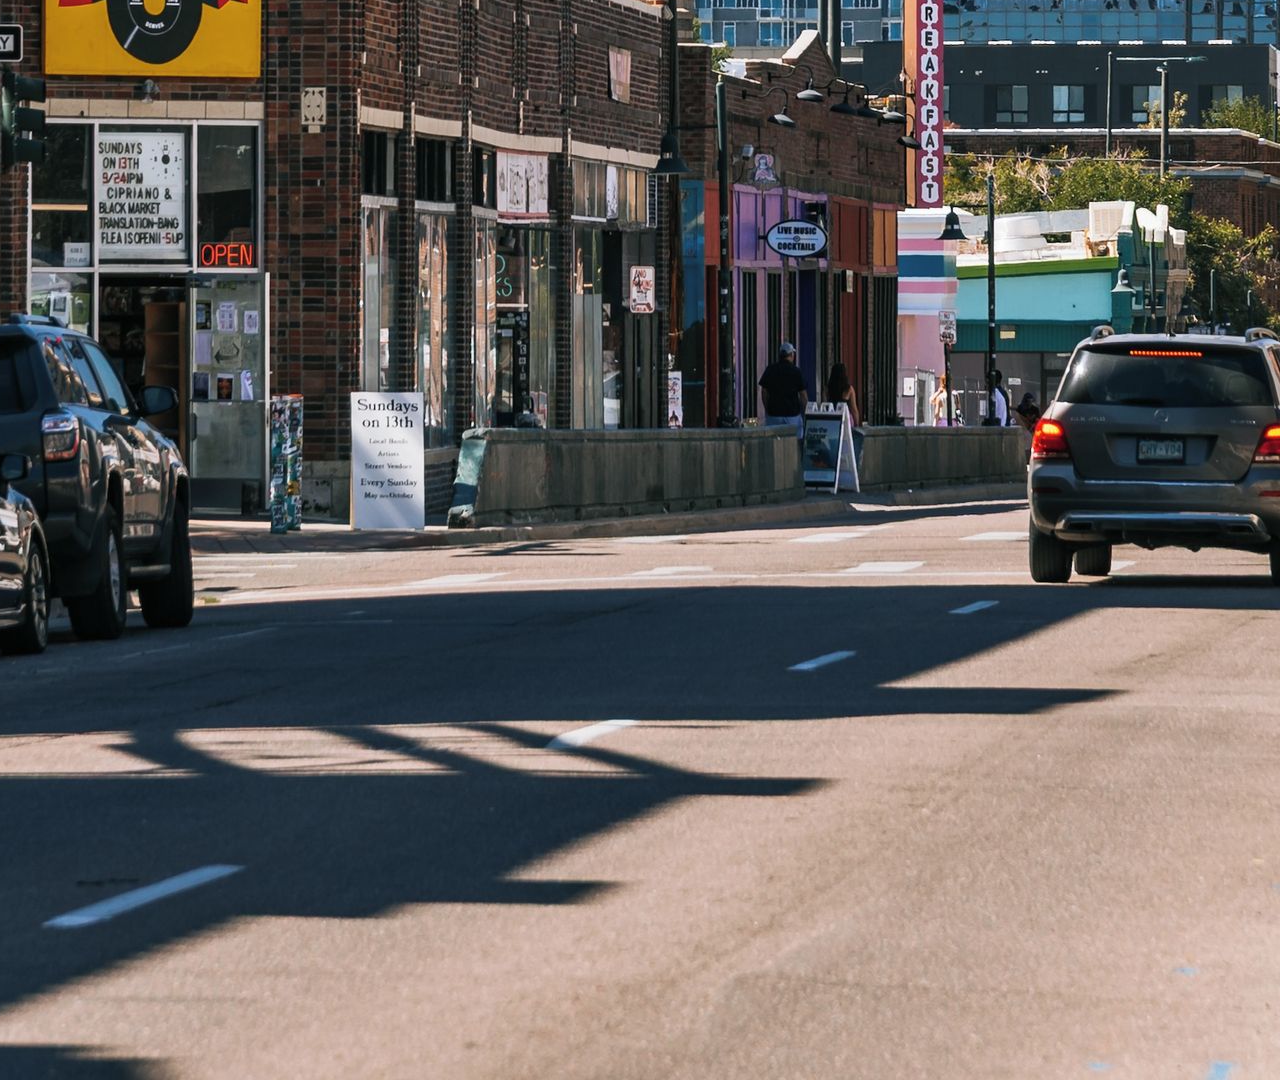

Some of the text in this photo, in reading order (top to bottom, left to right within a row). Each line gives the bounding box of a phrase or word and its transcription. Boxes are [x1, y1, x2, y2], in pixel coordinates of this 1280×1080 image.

[98, 142, 143, 155] SUNDAYS
[103, 157, 140, 169] ON 13TH
[107, 187, 173, 200] CIPRIANO &
[98, 202, 161, 215] BLACK MARKET
[777, 226, 816, 235] LIVE MUSIC
[101, 232, 122, 245] FLEA
[777, 242, 816, 251] COCKTAILS
[201, 243, 253, 267] OPEN
[357, 398, 419, 414] Sundays
[362, 415, 414, 428] on 13th
[360, 478, 417, 488] Every Sunday
[364, 491, 378, 499] May
